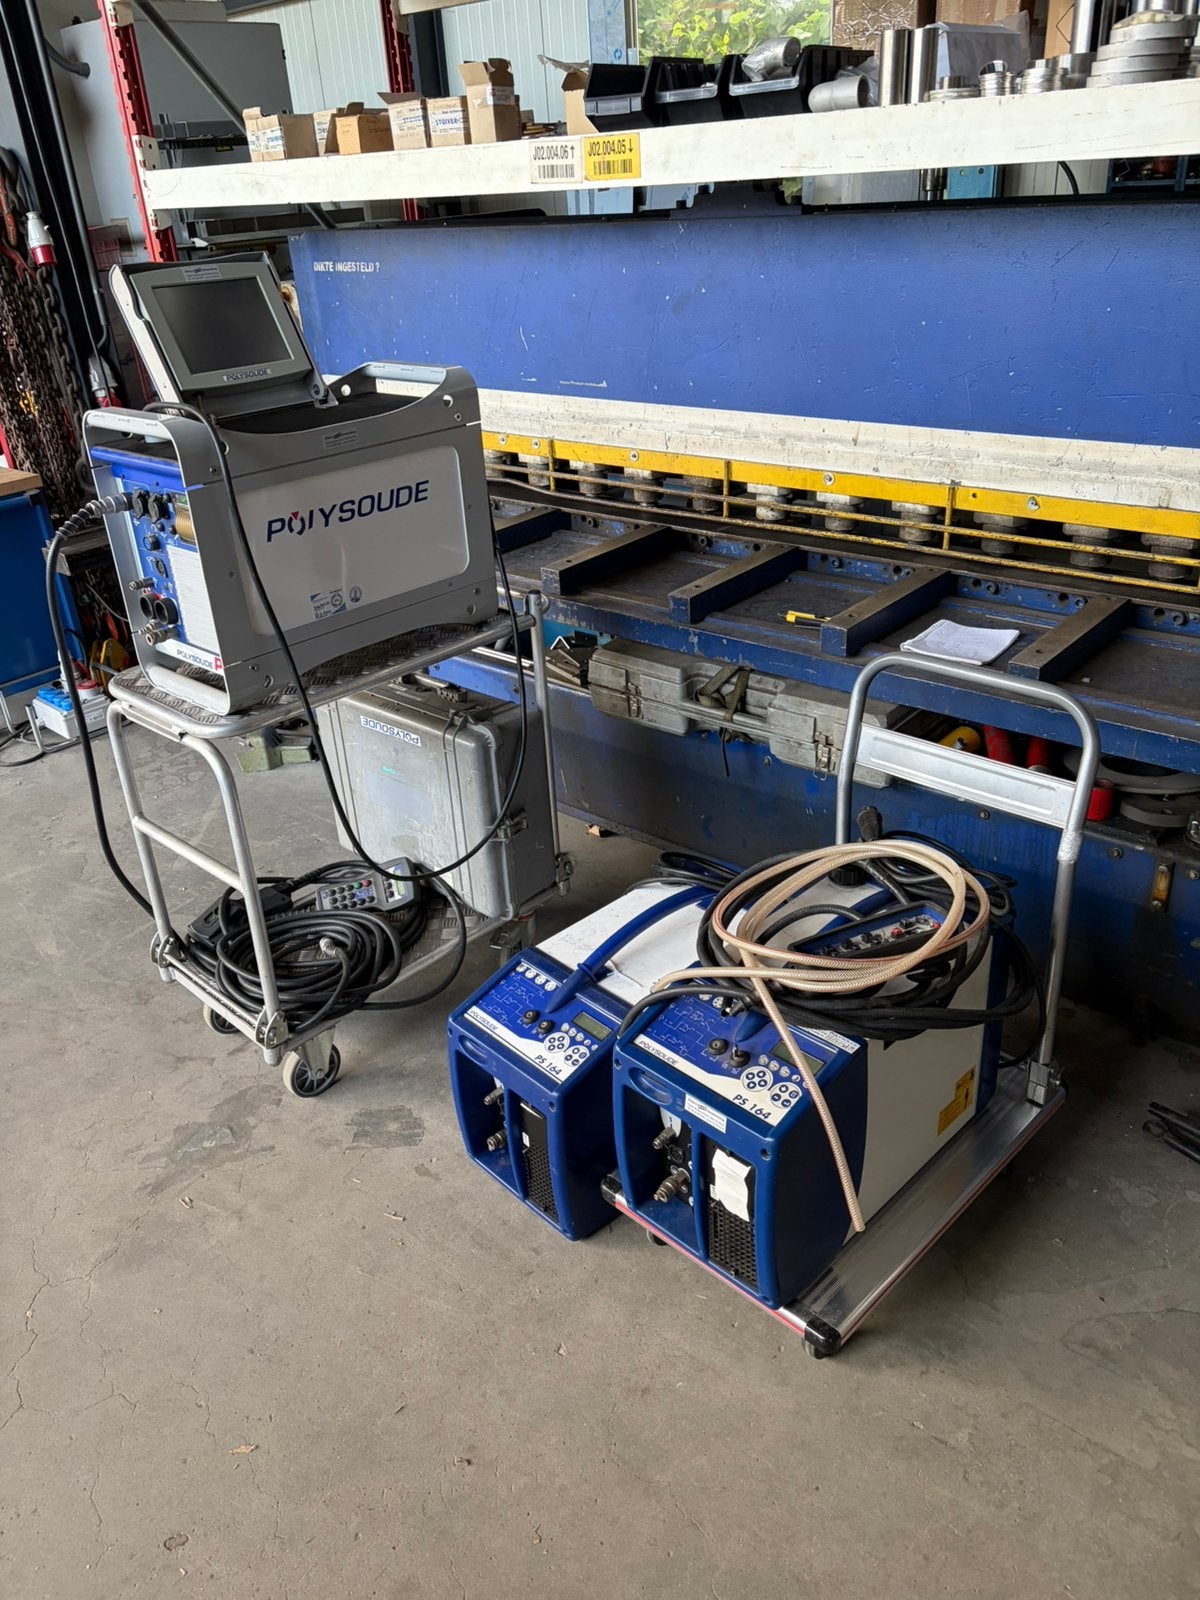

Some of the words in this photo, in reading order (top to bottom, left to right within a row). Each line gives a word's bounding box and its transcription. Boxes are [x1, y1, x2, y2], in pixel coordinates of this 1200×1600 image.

[533, 145, 569, 160] J02.004.06
[588, 139, 627, 157] J02.004.05
[313, 261, 334, 272] DIKTE
[335, 261, 375, 273] INGESTELD
[176, 648, 214, 669] POLYSOUDE
[361, 716, 420, 745] POLYSOUDE
[469, 1009, 499, 1032] POLYSOUDE
[638, 1040, 679, 1066] POLYSOUDE
[534, 1054, 548, 1065] PS
[546, 1060, 563, 1076] 164
[732, 1093, 749, 1107] PS
[748, 1103, 772, 1120] 164
